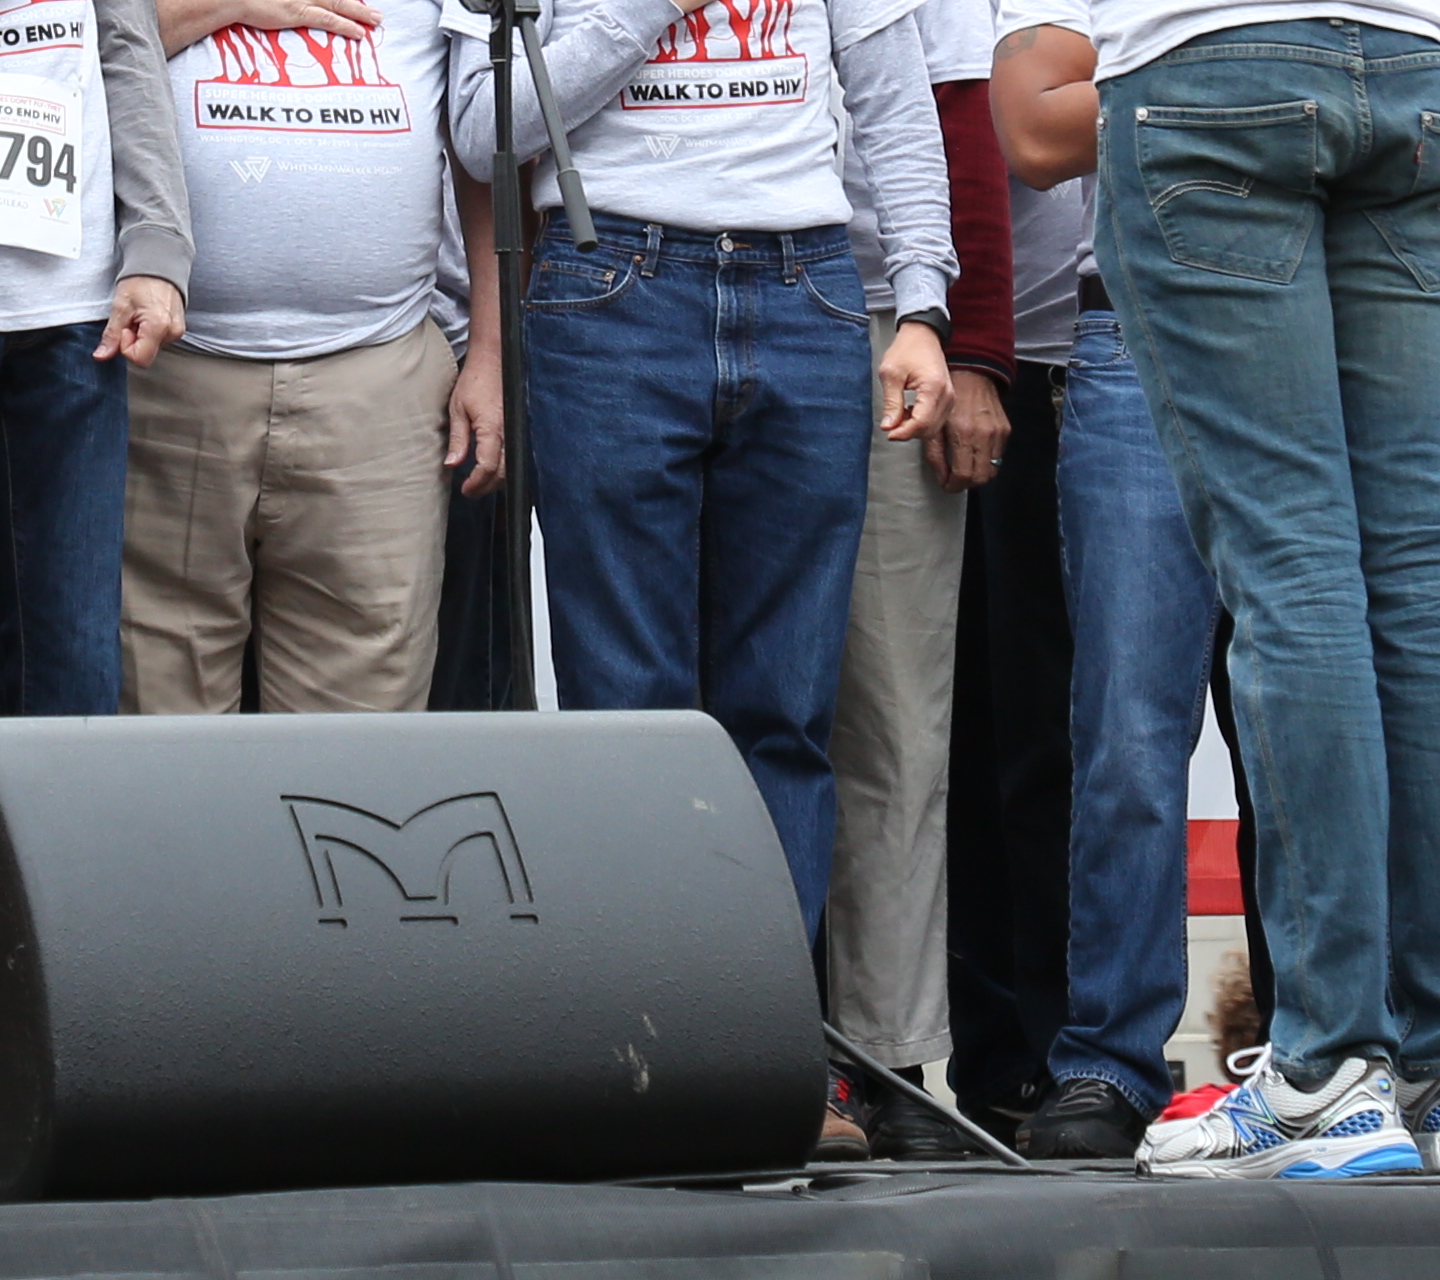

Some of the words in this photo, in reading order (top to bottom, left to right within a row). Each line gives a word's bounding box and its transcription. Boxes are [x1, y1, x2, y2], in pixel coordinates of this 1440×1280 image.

[25, 22, 67, 44] END
[634, 68, 665, 80] UPER
[667, 67, 713, 79] HEROES
[205, 88, 247, 100] SUPER
[249, 91, 299, 103] HEROES
[628, 83, 691, 102] WALK
[694, 83, 723, 100] TO
[728, 80, 769, 98] END
[773, 77, 802, 96] HIV
[16, 107, 40, 120] END
[43, 113, 61, 125] HIV
[206, 103, 279, 122] WALK
[281, 107, 313, 124] TO
[319, 107, 365, 125] END
[370, 107, 401, 126] HIV
